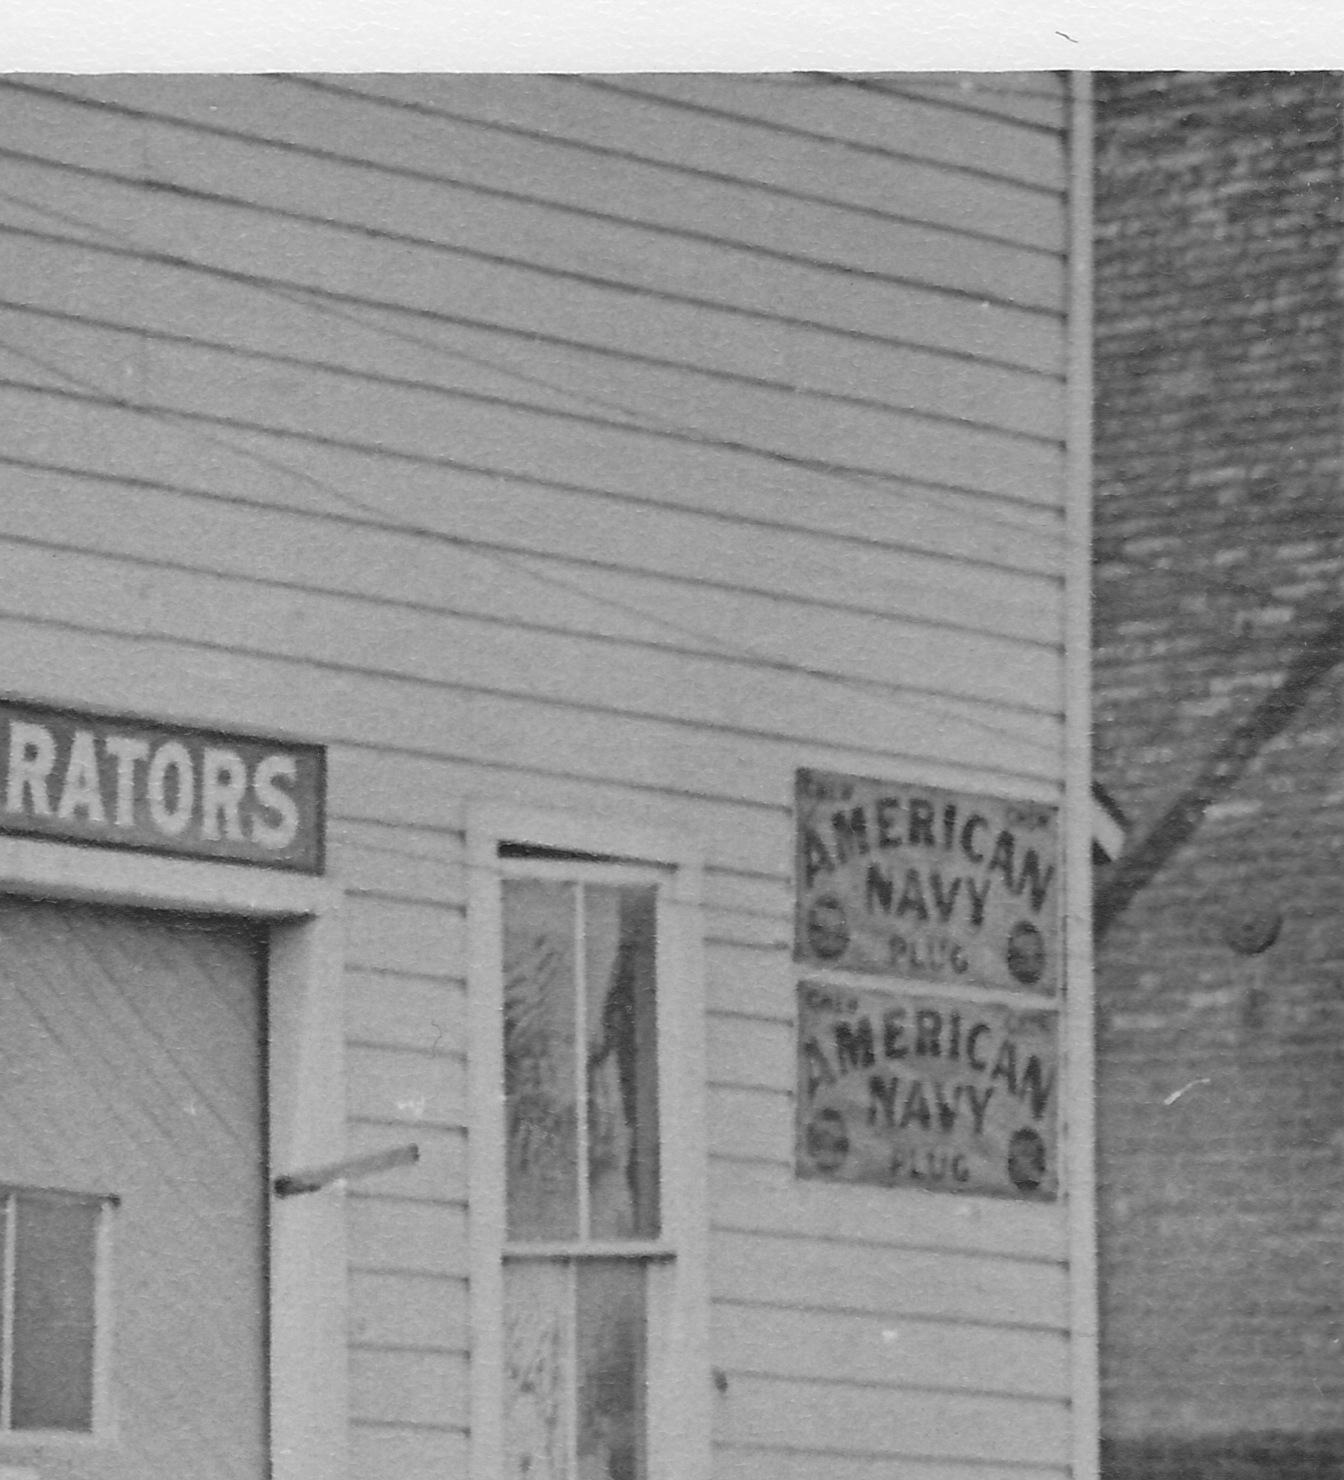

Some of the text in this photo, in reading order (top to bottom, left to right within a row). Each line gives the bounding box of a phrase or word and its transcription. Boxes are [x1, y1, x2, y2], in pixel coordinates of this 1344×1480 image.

[802, 797, 1055, 914] AMERICAN
[865, 861, 991, 926] NAVY
[803, 1008, 1056, 1120] AMERICAN
[866, 1076, 995, 1134] NAVY
